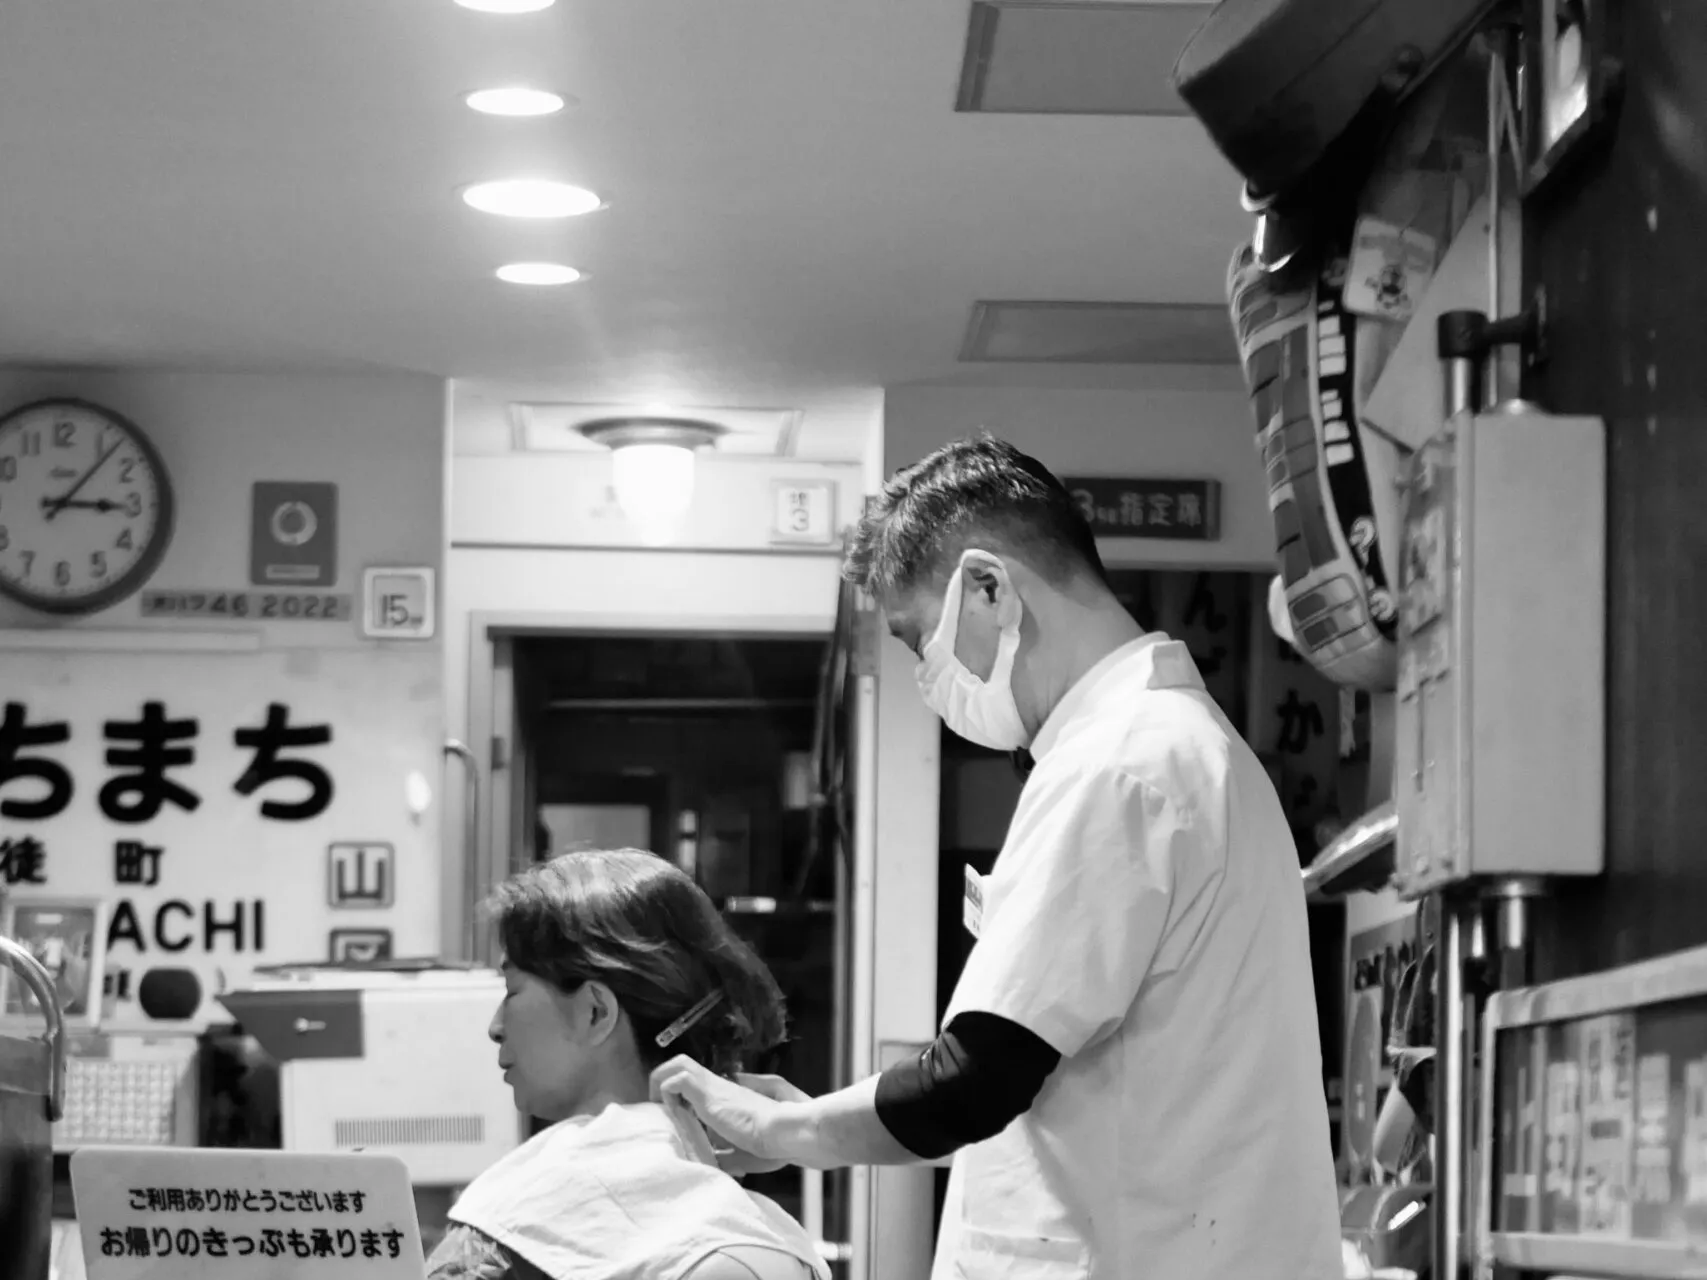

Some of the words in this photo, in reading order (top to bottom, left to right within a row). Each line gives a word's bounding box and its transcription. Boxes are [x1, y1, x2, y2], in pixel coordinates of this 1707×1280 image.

[21, 431, 41, 456] 11
[54, 422, 76, 448] 12
[120, 458, 134, 483] 2
[126, 492, 142, 518] 3
[116, 529, 133, 550] 4
[20, 551, 36, 576] 7
[54, 561, 71, 587] 6
[90, 552, 107, 578] 5
[382, 594, 410, 626] 15
[128, 1188, 366, 1214] ご利用ありがとうございます
[100, 1226, 405, 1259] お帰りのきっぷも承ります
